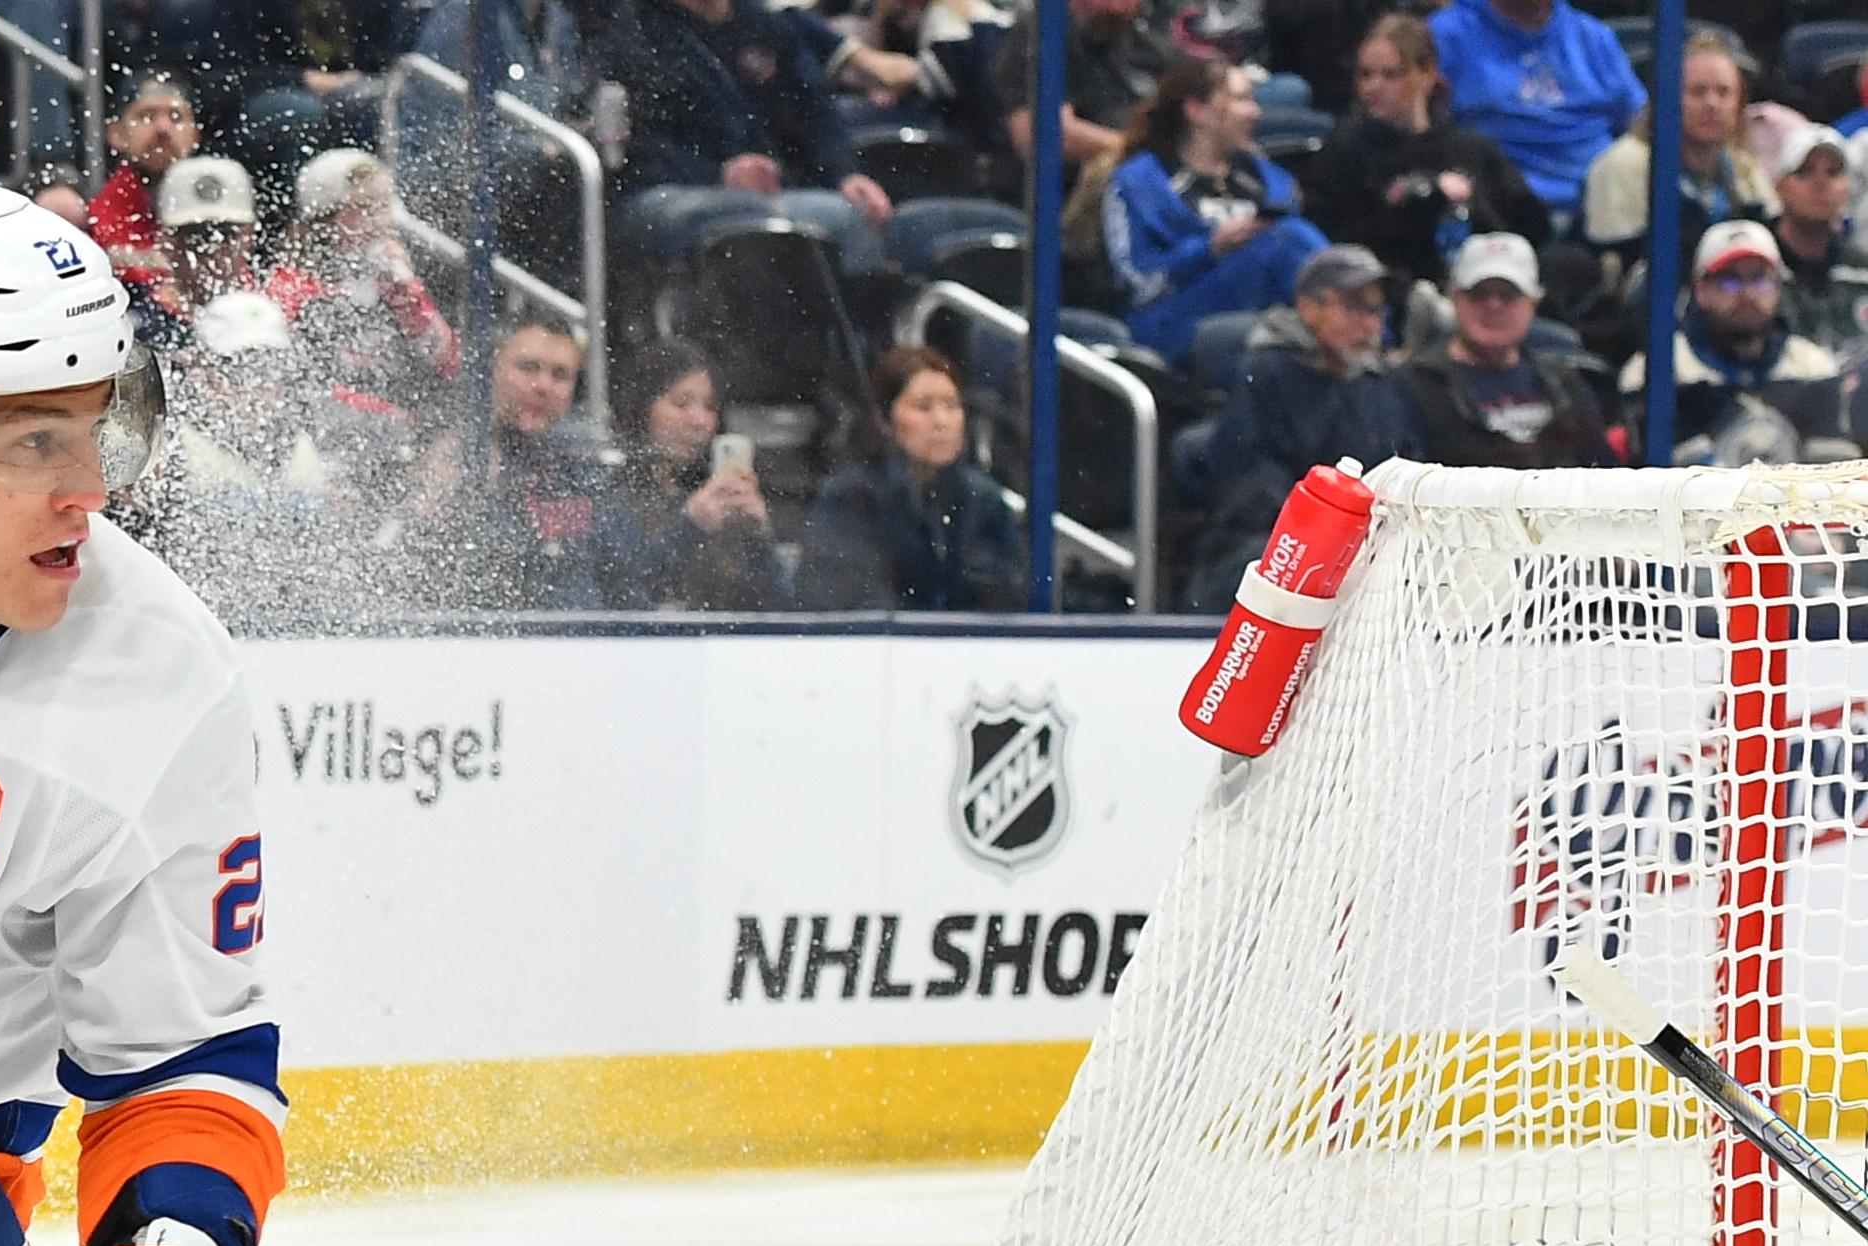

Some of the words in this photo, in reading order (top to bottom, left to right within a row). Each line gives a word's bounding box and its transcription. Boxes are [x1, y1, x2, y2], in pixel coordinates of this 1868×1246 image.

[1195, 621, 1258, 725] BODYARMOR
[1259, 642, 1315, 745] BODYARMOR
[278, 700, 503, 807] Village!
[211, 831, 264, 956] 2
